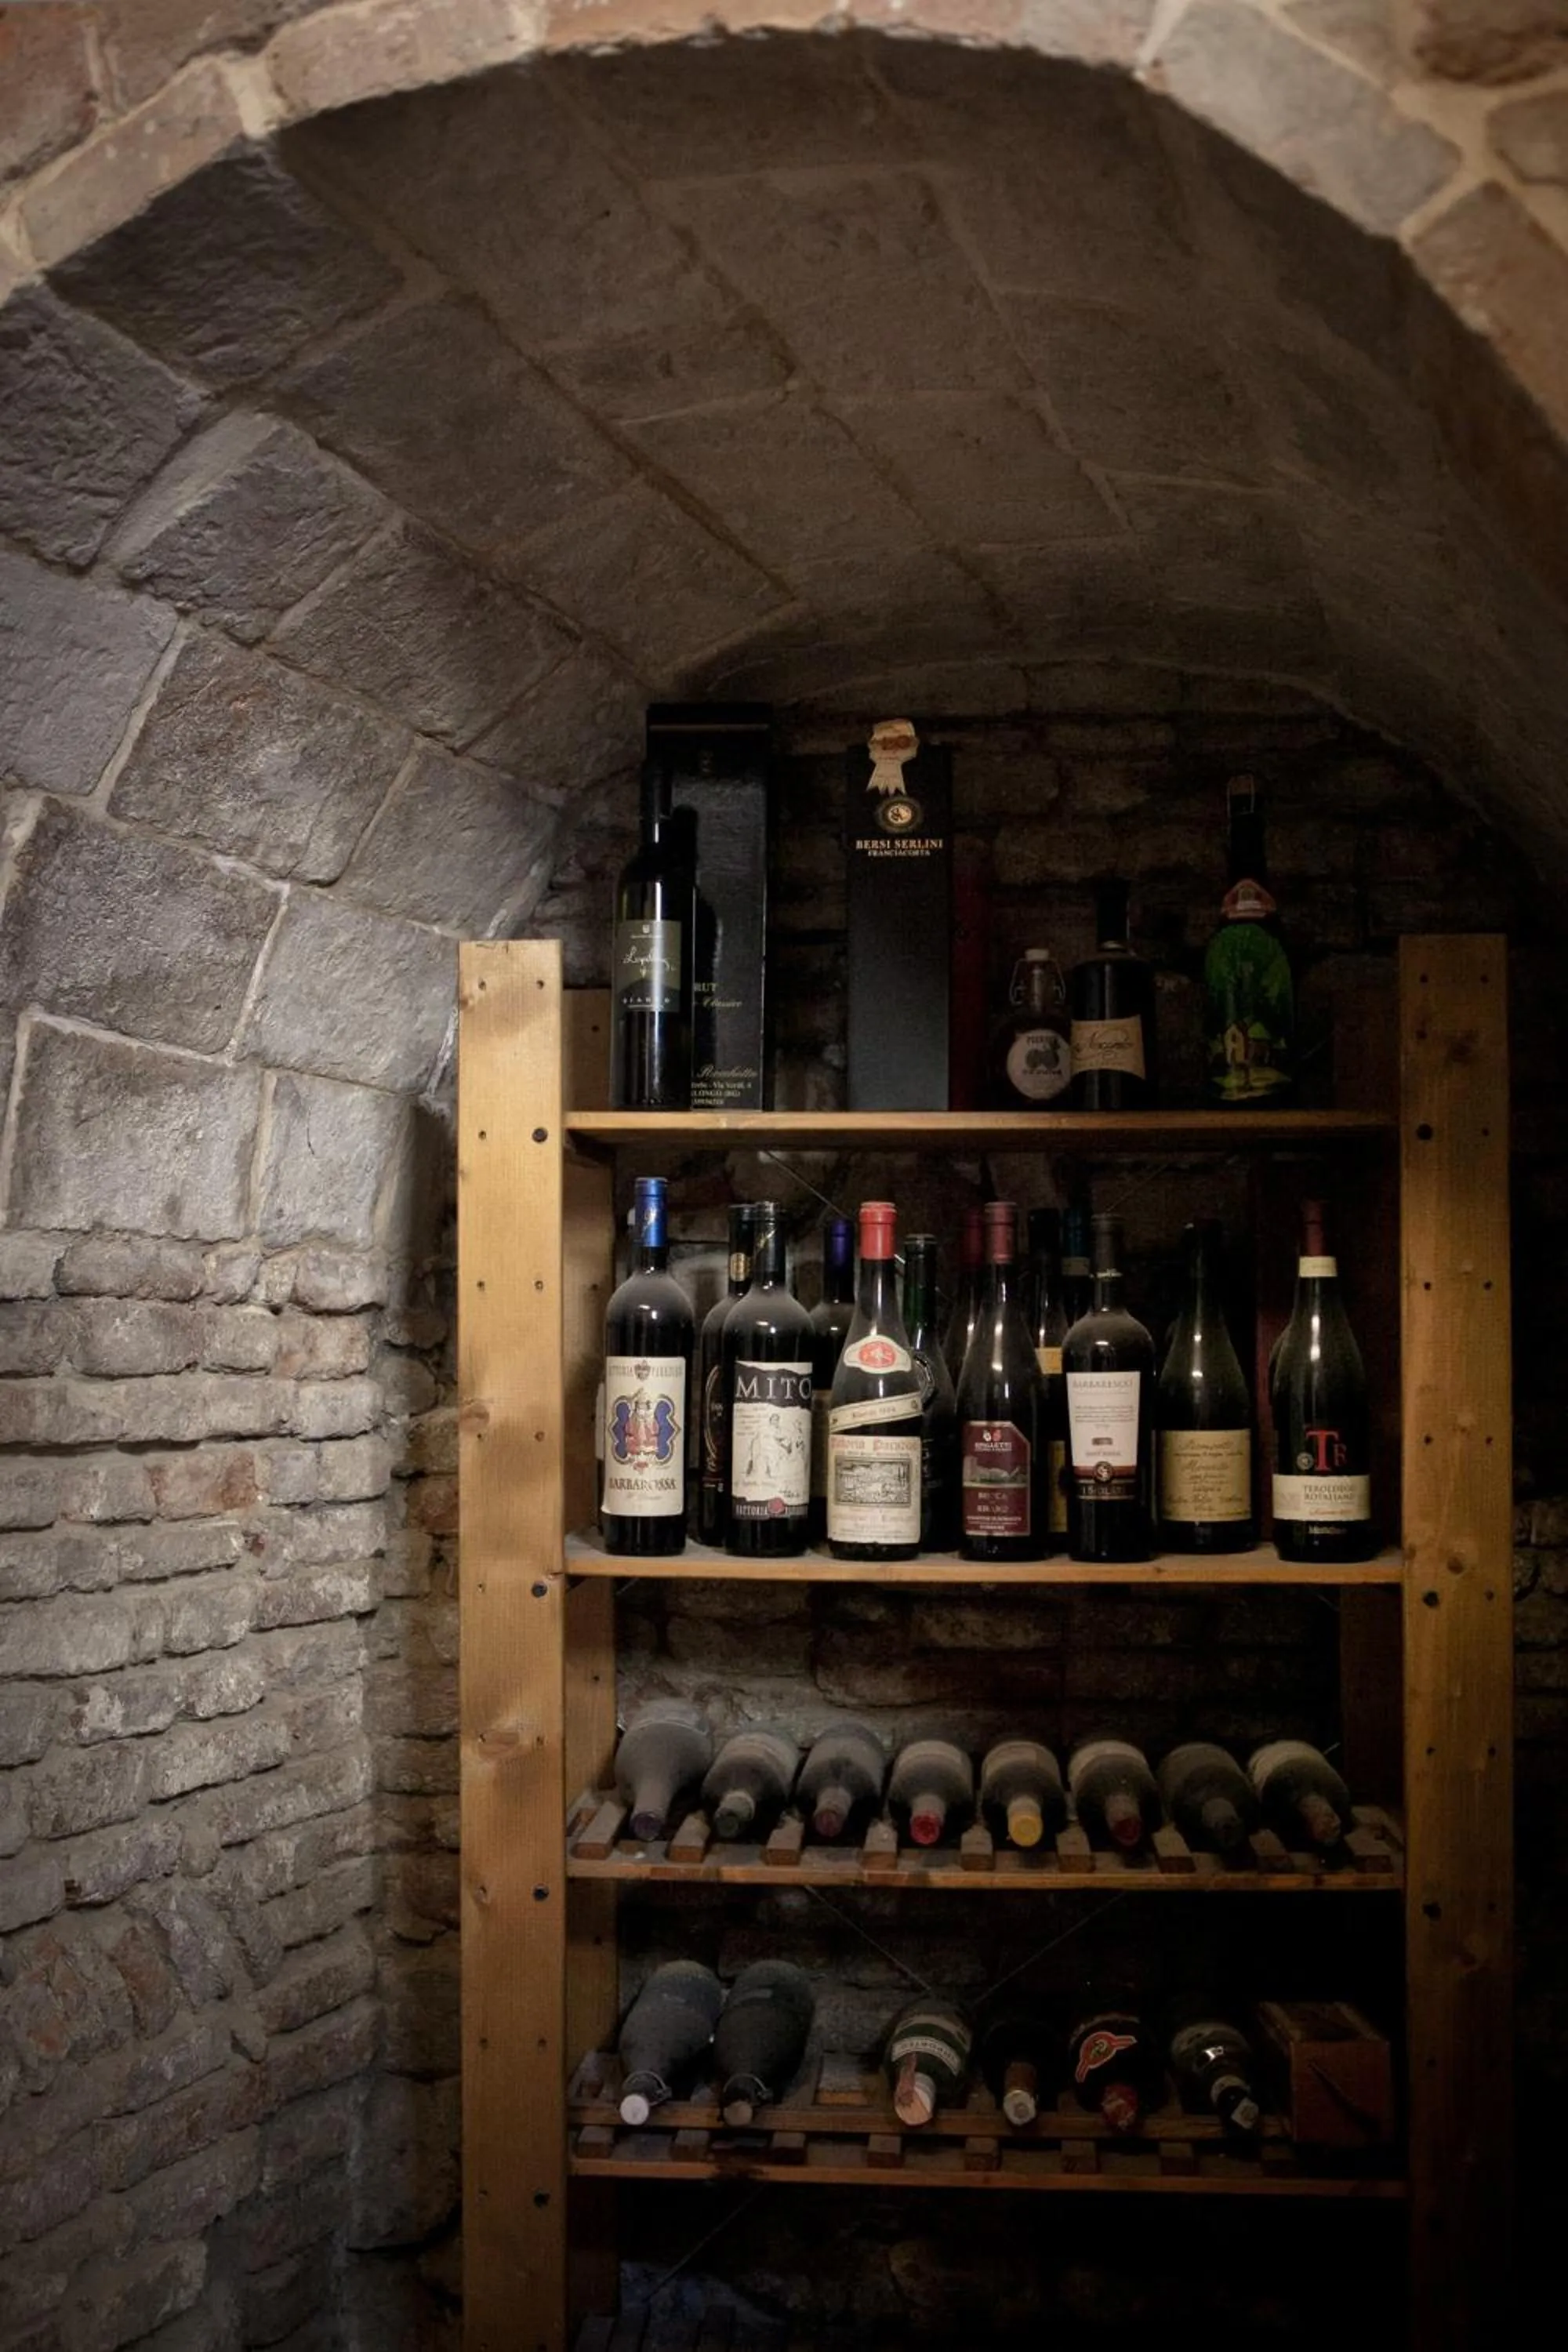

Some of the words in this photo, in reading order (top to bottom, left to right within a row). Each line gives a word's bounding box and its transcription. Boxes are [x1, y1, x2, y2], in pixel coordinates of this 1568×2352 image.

[855, 840, 891, 849] BERSI
[895, 839, 944, 849] SERLINI
[693, 982, 717, 993] RUT
[735, 1375, 811, 1400] MITO
